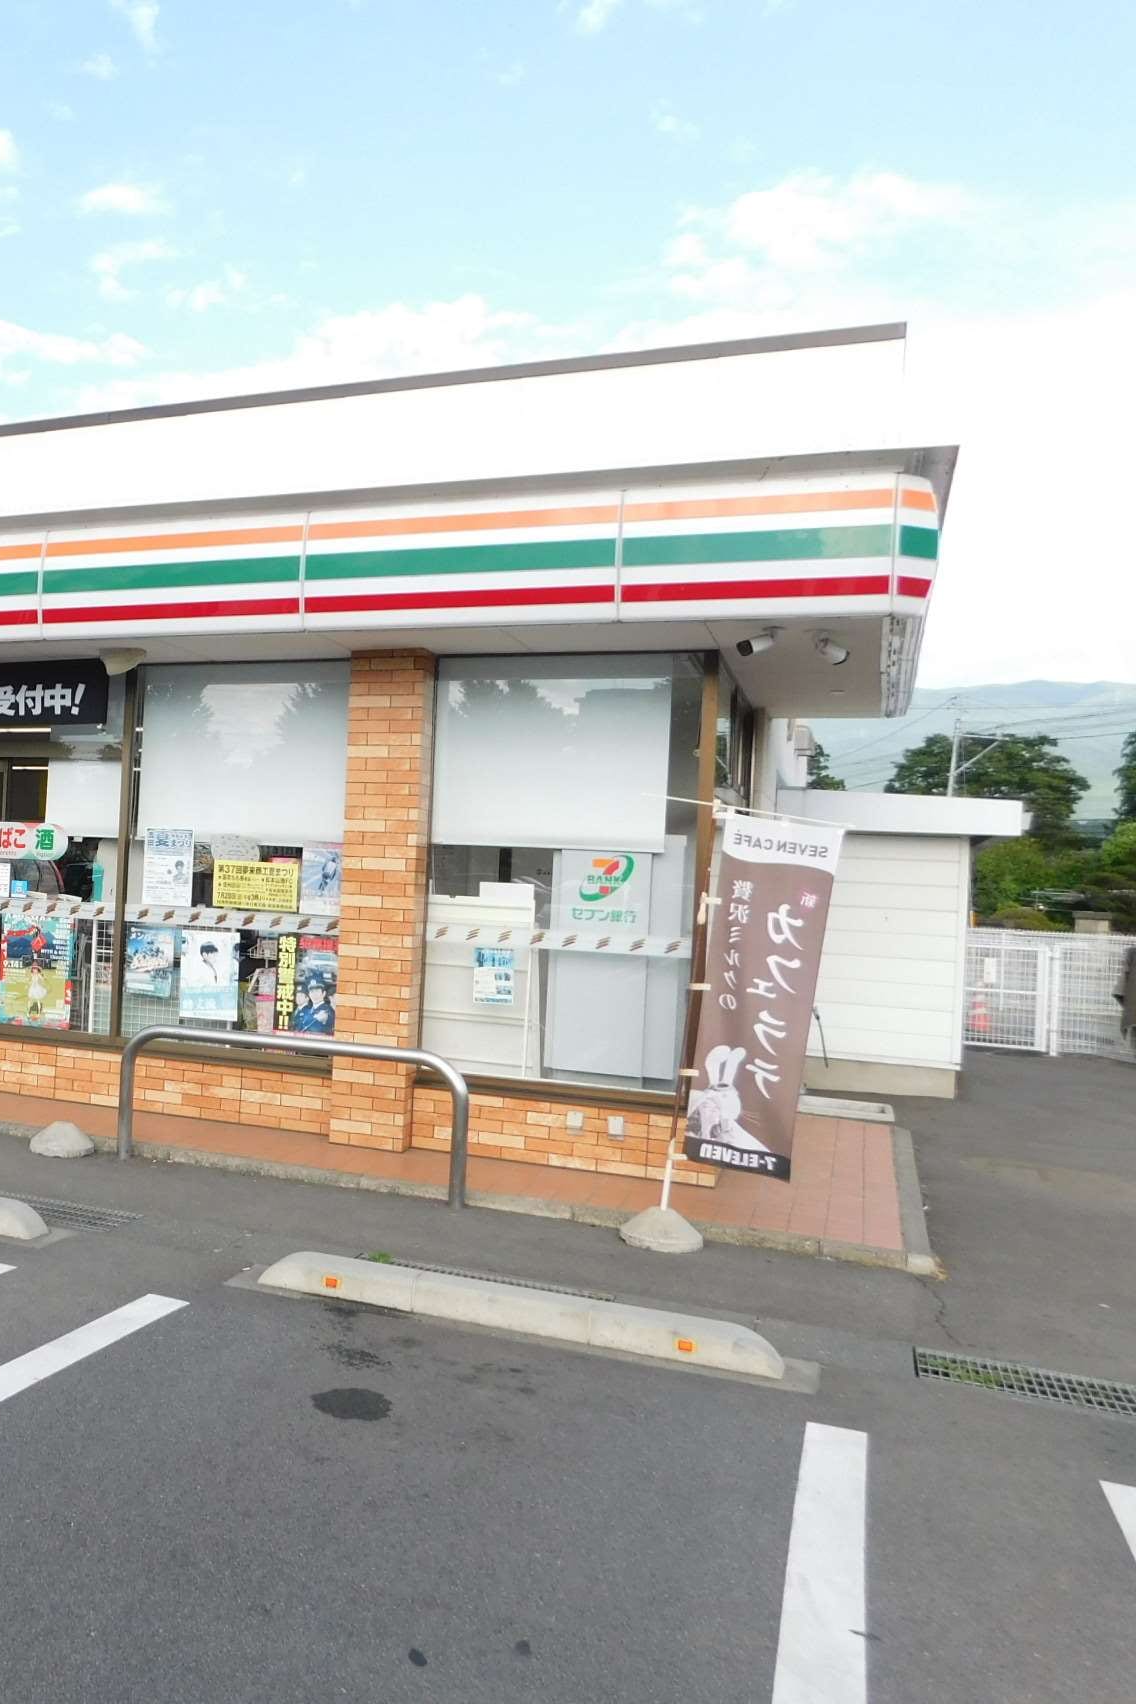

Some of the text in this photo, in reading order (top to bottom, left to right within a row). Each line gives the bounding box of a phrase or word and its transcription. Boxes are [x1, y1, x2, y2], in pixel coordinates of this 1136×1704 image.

[36, 829, 55, 850] 酒
[572, 907, 637, 924] セブン銀行
